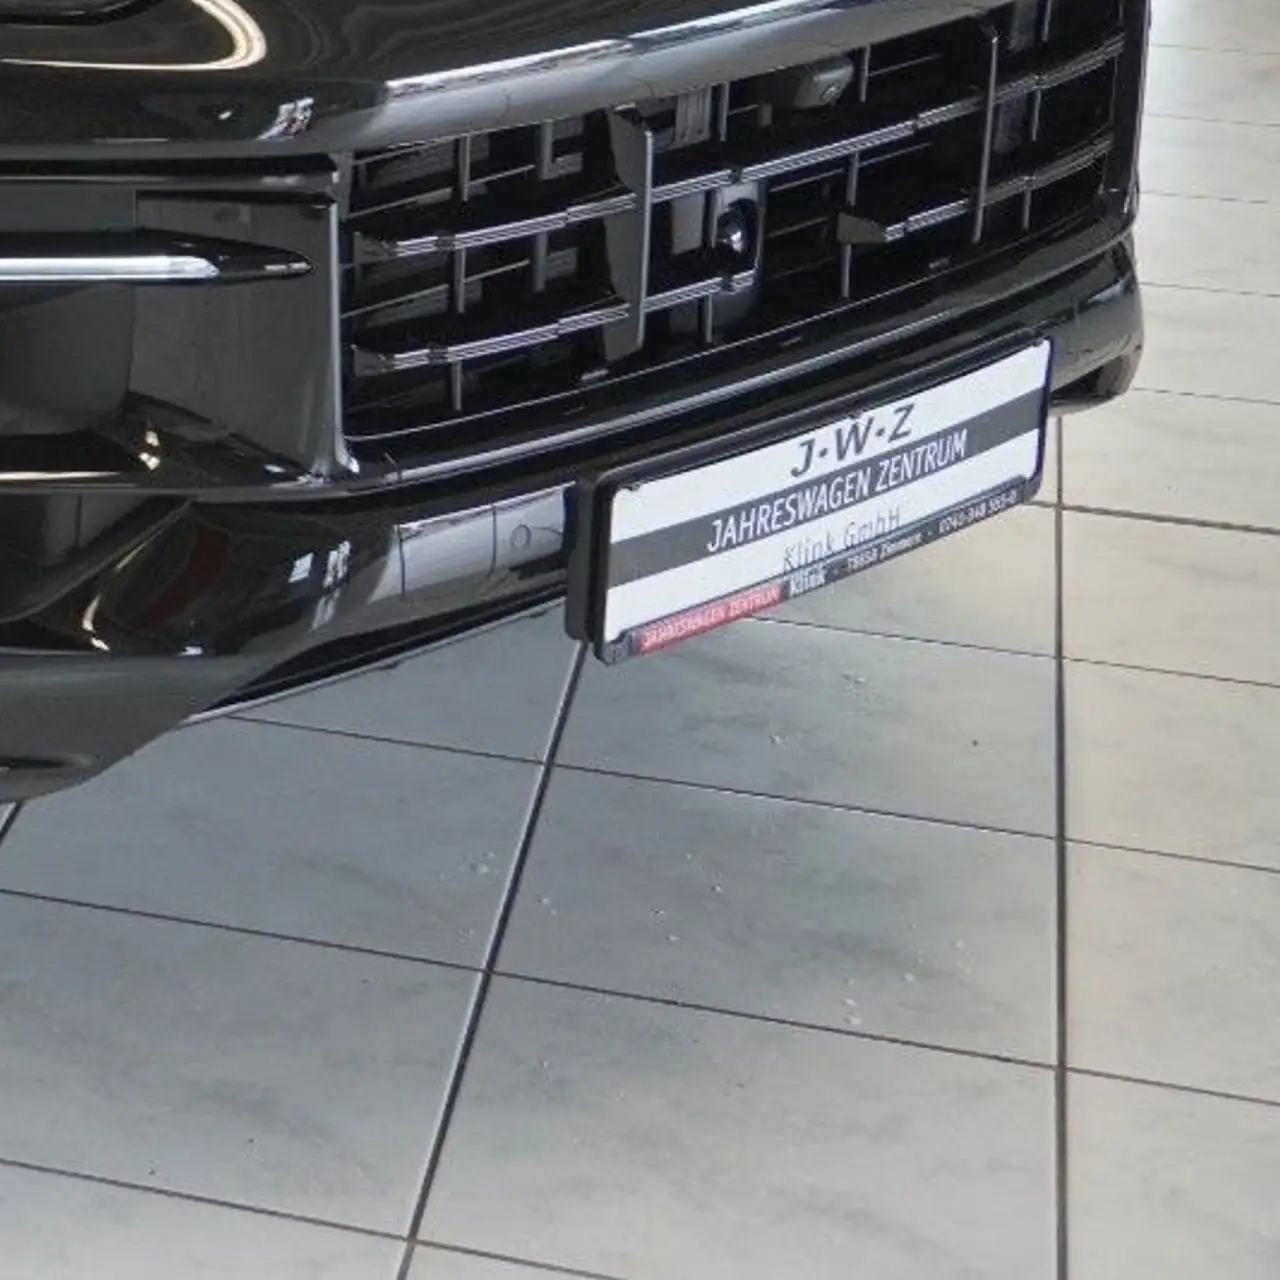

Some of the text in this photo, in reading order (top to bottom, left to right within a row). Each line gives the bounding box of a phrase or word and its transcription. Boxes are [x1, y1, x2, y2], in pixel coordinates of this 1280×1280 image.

[706, 466, 872, 552] JAHRESWAGEN
[874, 428, 969, 493] ZENTRUM
[783, 531, 834, 571] Klink
[843, 505, 900, 548] GmbH
[790, 563, 827, 596] Klink
